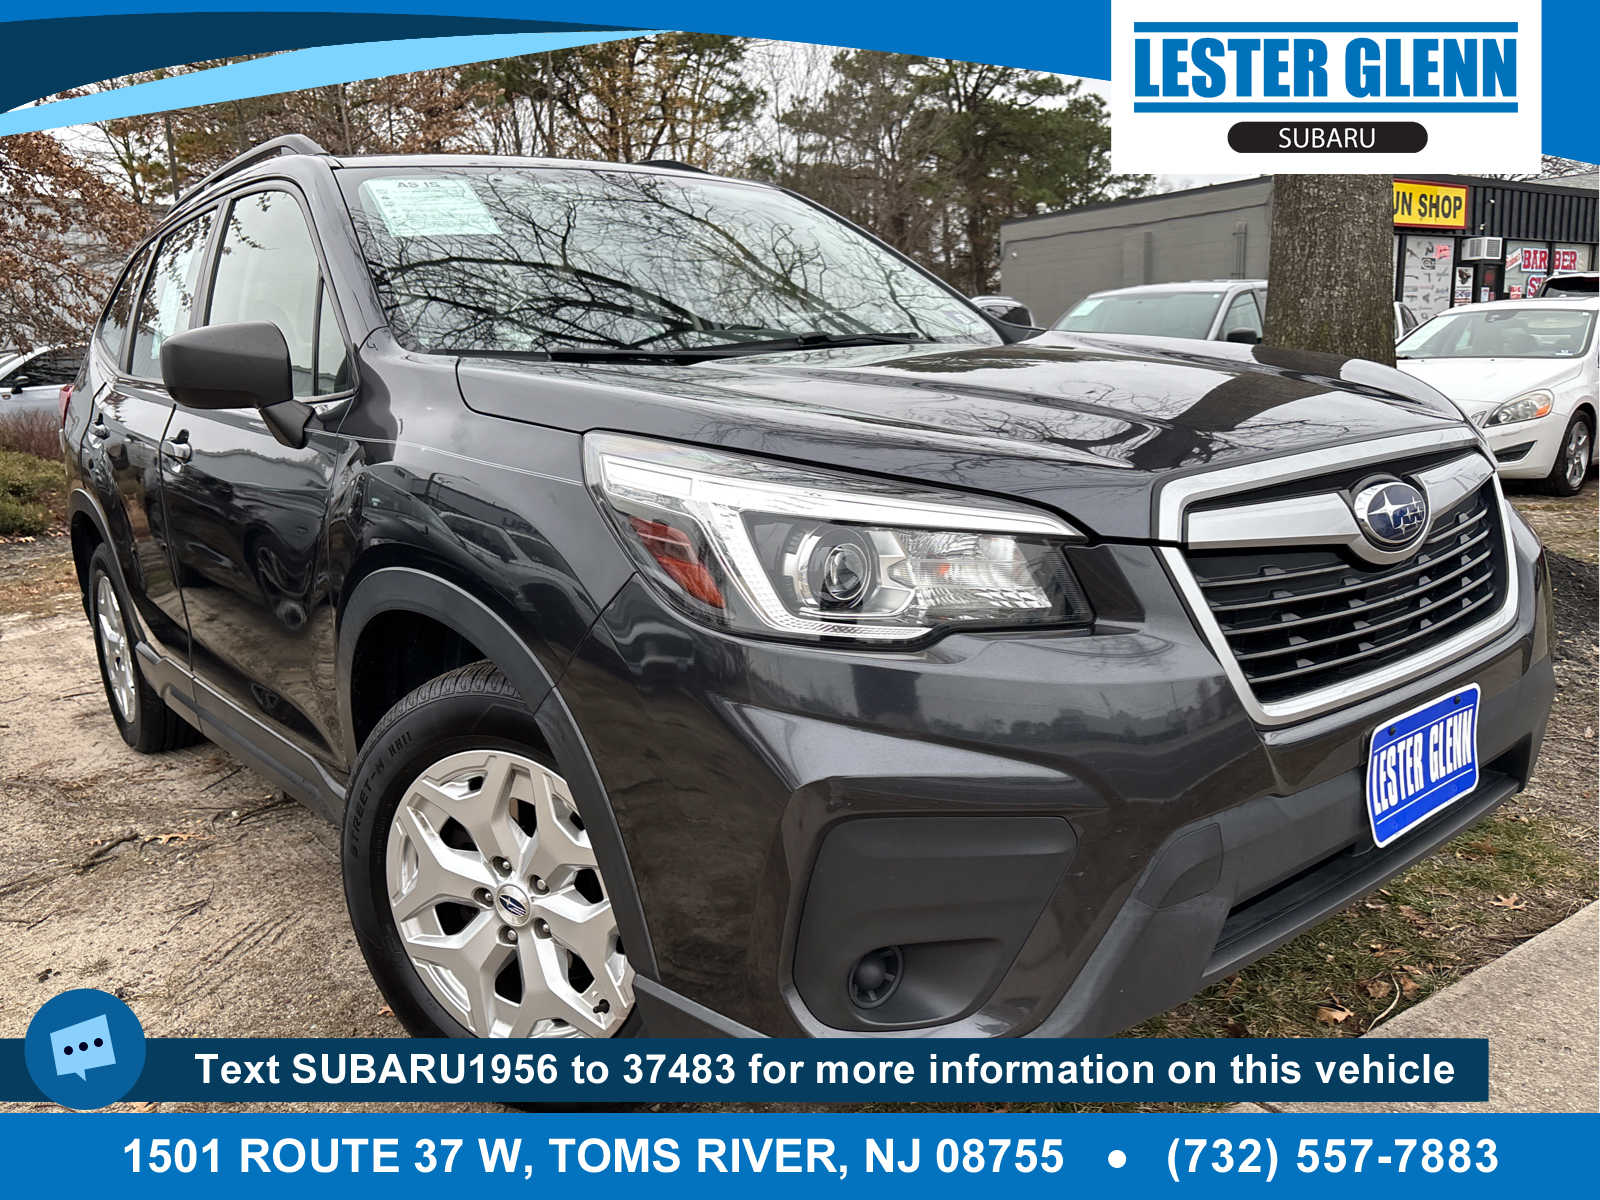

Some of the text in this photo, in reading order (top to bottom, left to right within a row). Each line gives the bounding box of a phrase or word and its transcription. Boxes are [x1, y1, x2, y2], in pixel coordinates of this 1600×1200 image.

[1393, 191, 1462, 219] UN SHOP
[1372, 708, 1473, 816] LESTER GLENN
